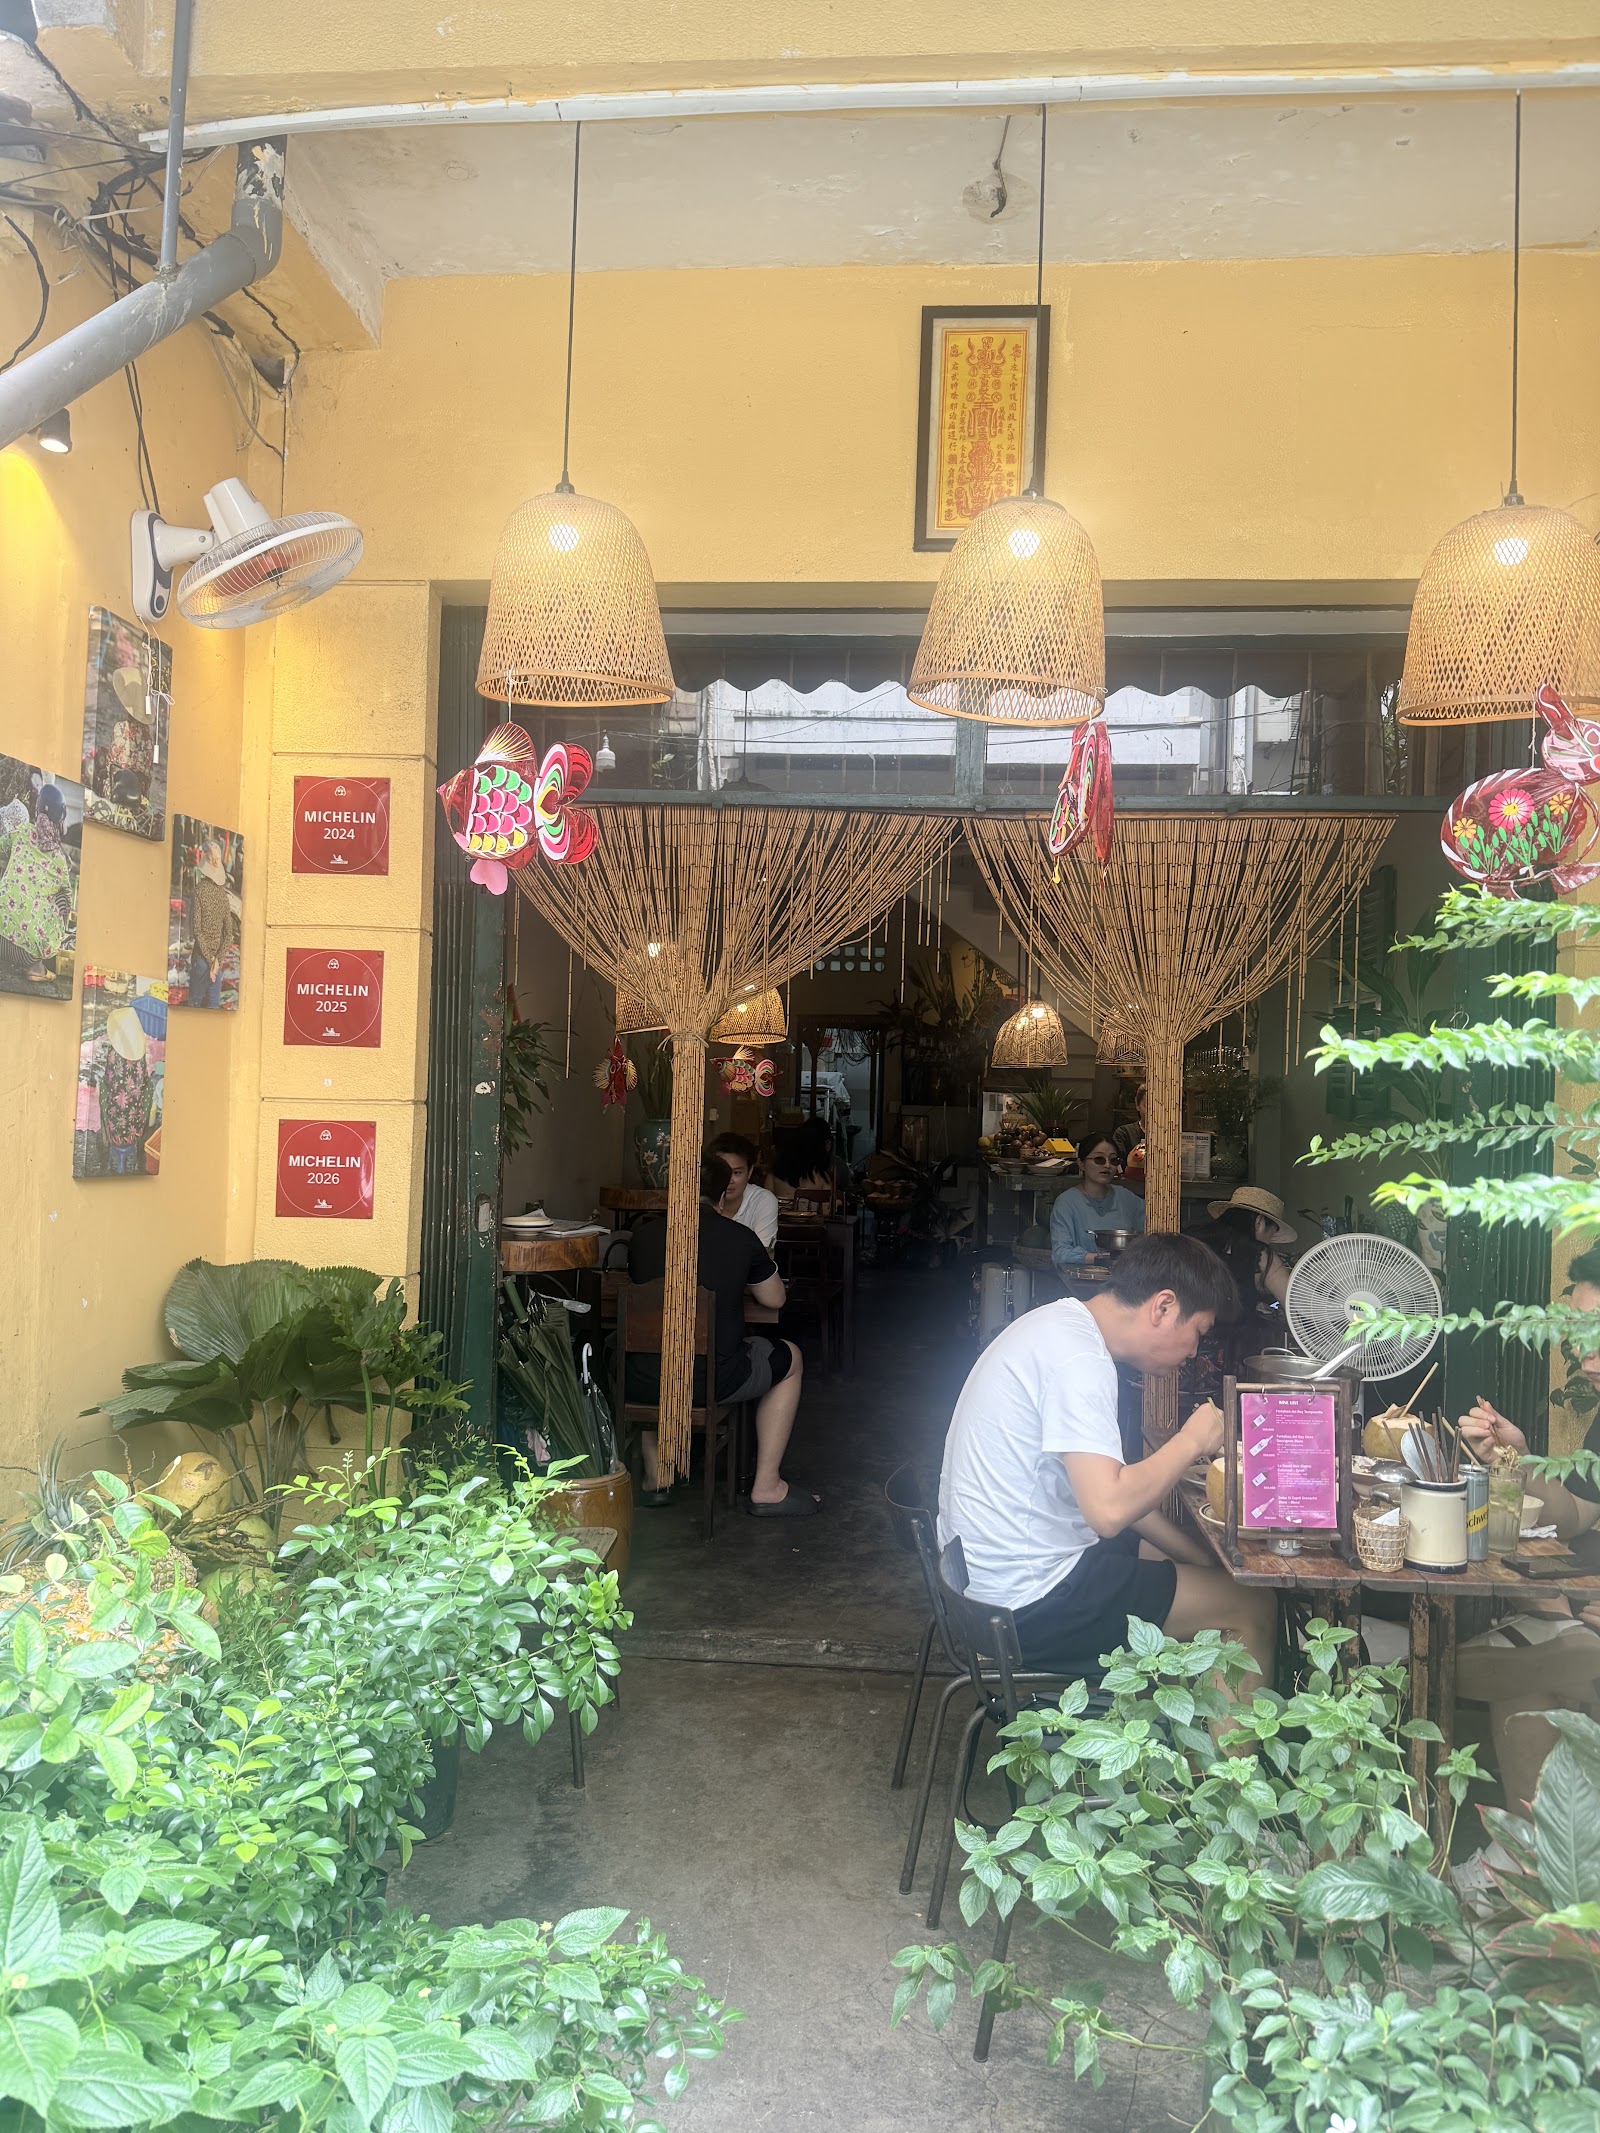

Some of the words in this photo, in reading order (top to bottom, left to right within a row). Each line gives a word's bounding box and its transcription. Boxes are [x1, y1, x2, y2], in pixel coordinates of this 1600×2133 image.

[304, 810, 377, 824] MICHELIN
[323, 827, 356, 840] 2024
[297, 983, 369, 997] MICHELIN
[315, 1000, 348, 1013] 2025
[288, 1154, 362, 1169] MICHELIN
[306, 1172, 340, 1185] 2026
